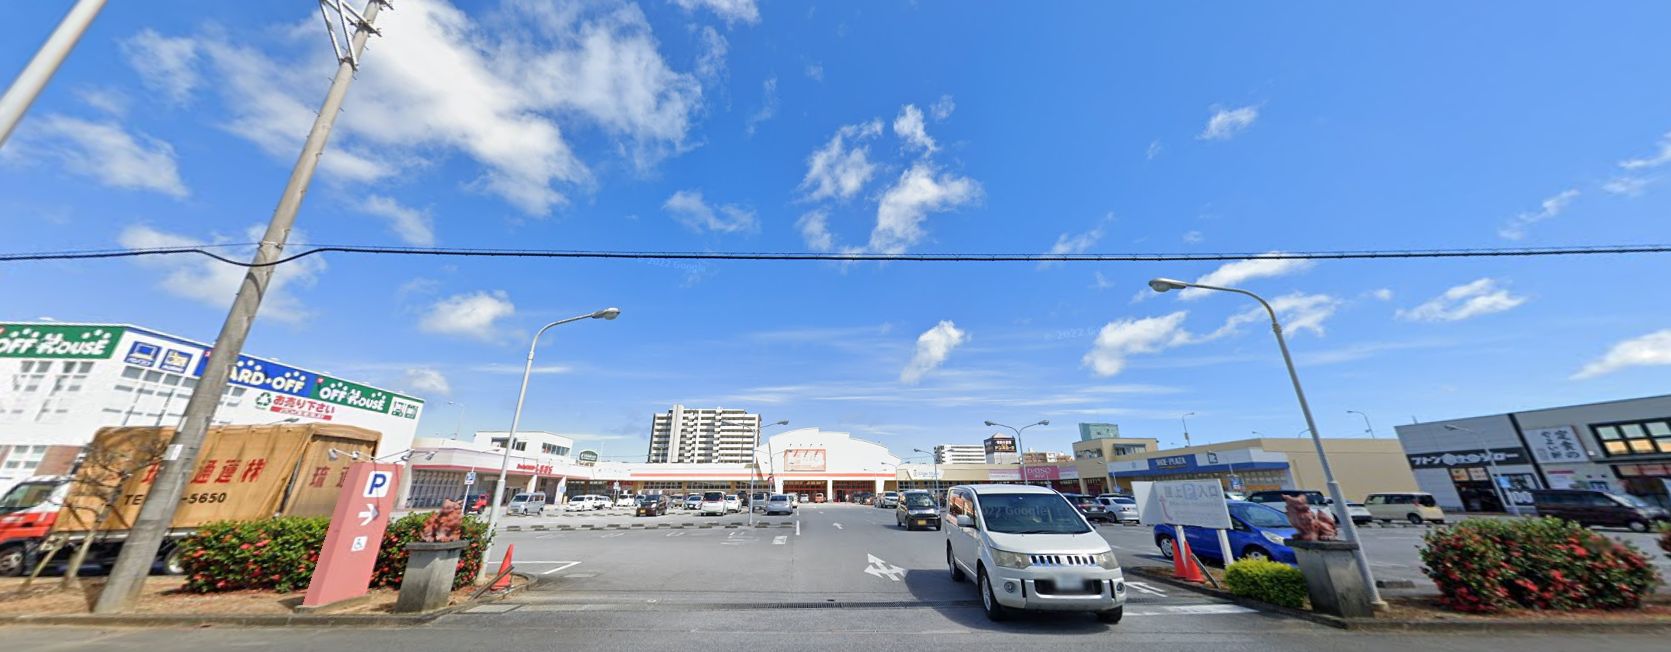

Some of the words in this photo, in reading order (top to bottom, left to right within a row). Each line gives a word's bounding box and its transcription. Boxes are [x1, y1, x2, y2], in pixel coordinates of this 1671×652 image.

[0, 337, 38, 354] OFF
[36, 333, 110, 355] HOUSE
[319, 386, 347, 402] OFF
[347, 388, 386, 410] HOUSE
[367, 473, 387, 495] P
